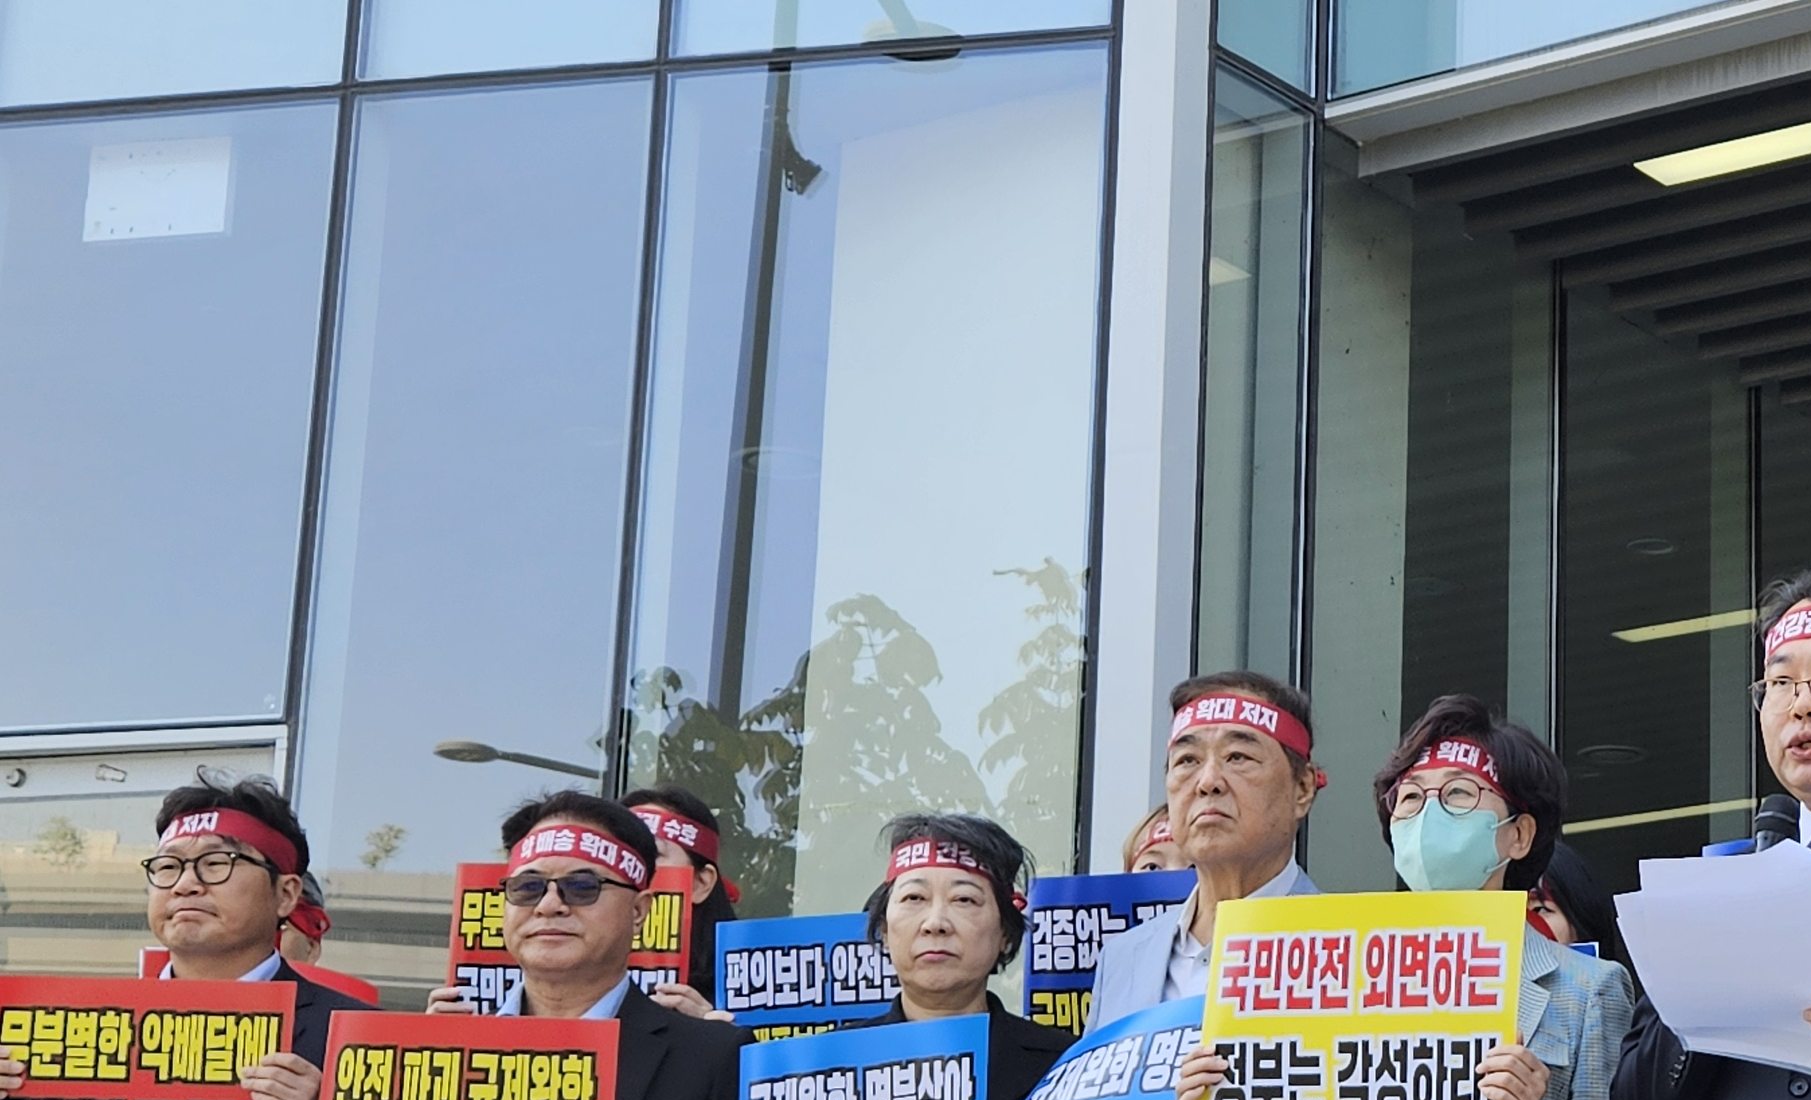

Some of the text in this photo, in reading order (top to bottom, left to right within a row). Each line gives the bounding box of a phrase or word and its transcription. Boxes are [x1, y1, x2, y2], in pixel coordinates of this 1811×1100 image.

[1196, 697, 1237, 721] 확대
[1239, 700, 1279, 734] 저지
[1436, 739, 1481, 766] 확대
[178, 810, 220, 836] 저지
[662, 814, 700, 848] 수호
[536, 828, 576, 852] 배송
[579, 831, 619, 866] 확대
[619, 848, 646, 884] 저지
[895, 841, 931, 869] 국민
[460, 890, 508, 949] 무분
[725, 946, 826, 1010] 편의보다
[1221, 931, 1501, 1012] 국민안전 외면하는
[0, 1010, 133, 1079] 무분별한
